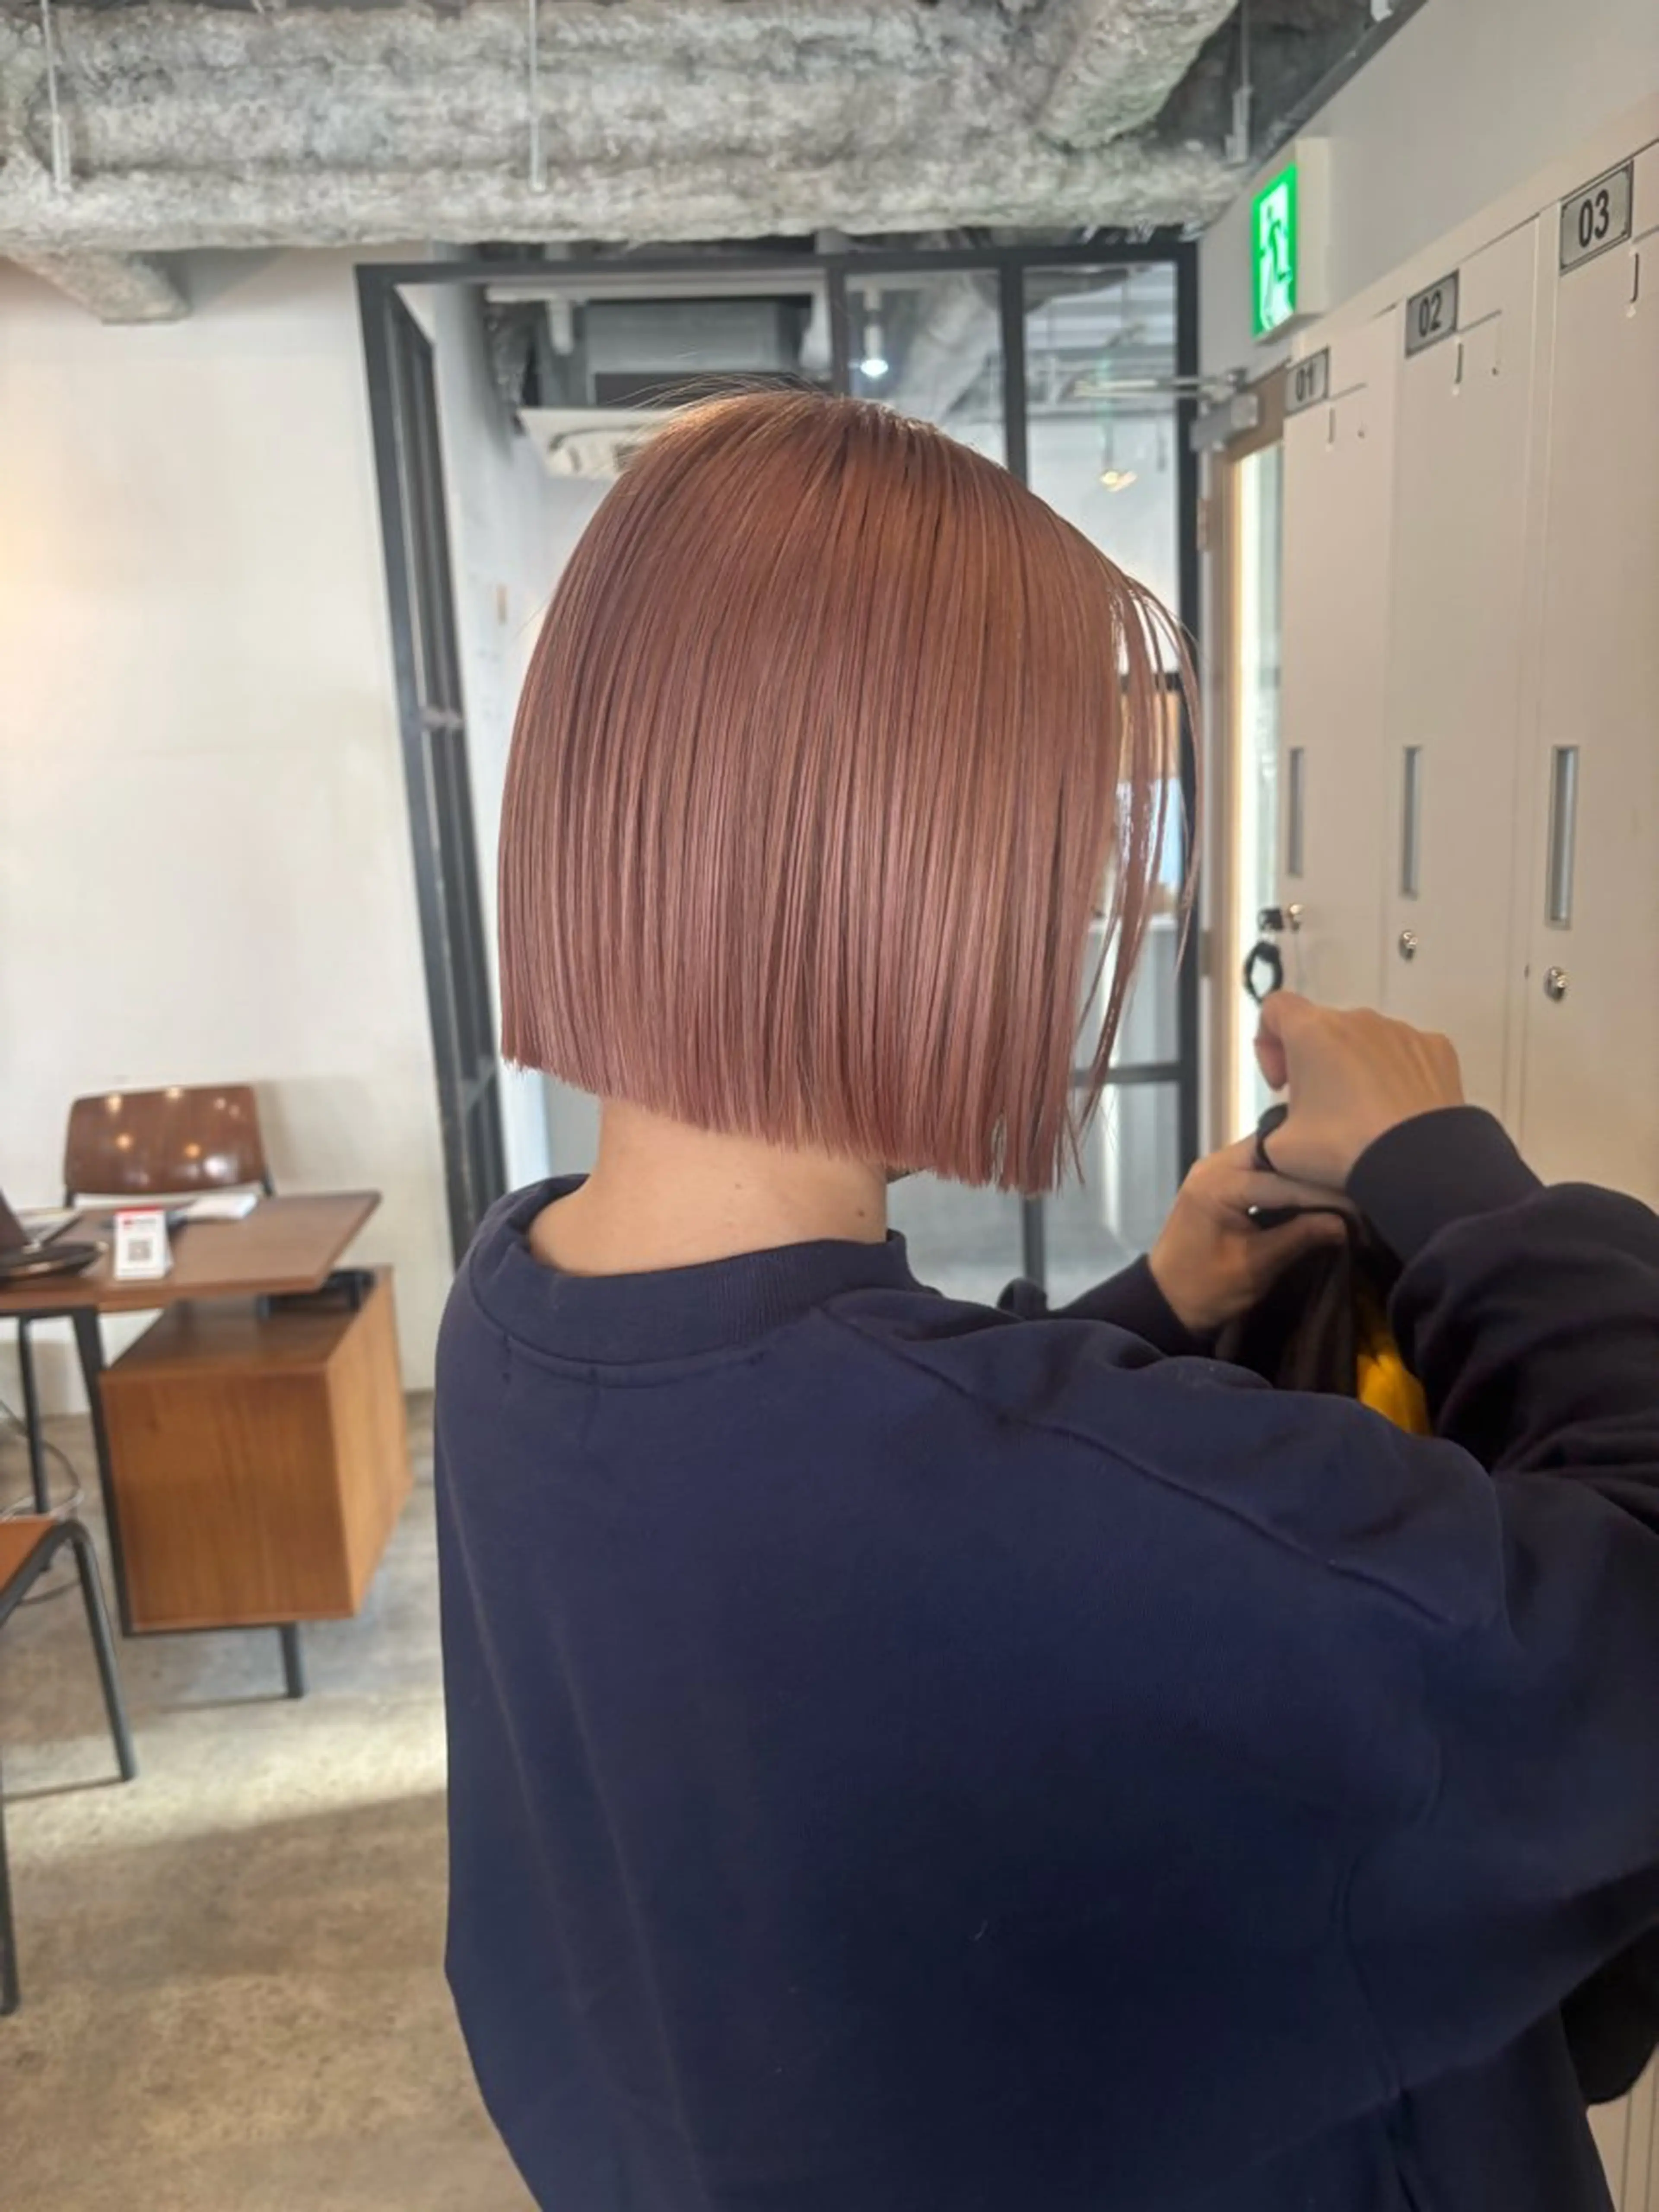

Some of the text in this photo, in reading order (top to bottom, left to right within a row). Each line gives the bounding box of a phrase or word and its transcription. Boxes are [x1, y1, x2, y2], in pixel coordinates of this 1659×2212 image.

[1579, 188, 1609, 248] 03
[1418, 289, 1442, 337] 02
[1295, 362, 1314, 403] 01
